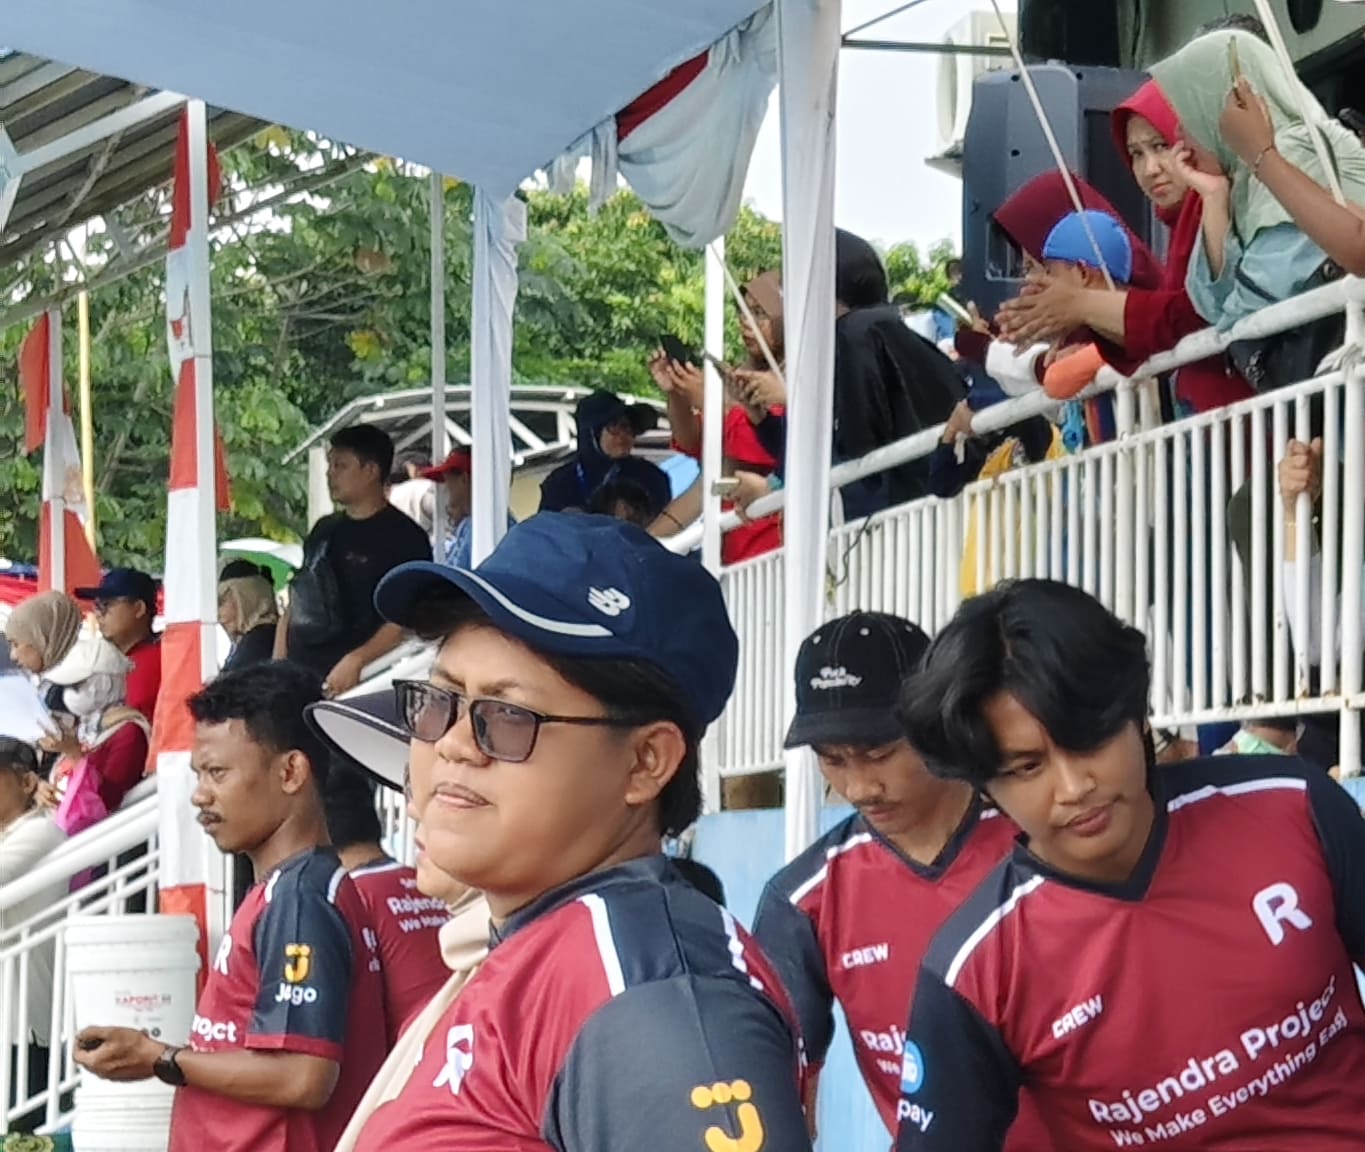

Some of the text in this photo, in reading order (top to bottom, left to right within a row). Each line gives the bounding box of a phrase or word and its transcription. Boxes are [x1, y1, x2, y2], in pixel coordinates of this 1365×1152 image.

[1253, 882, 1313, 946] R
[842, 943, 889, 969] CREW
[1051, 995, 1104, 1040] CREW
[1089, 1047, 1239, 1125] Rajendra
[1111, 1128, 1145, 1148] We
[1145, 1111, 1207, 1144] Make
[1208, 1042, 1316, 1117] Everything
